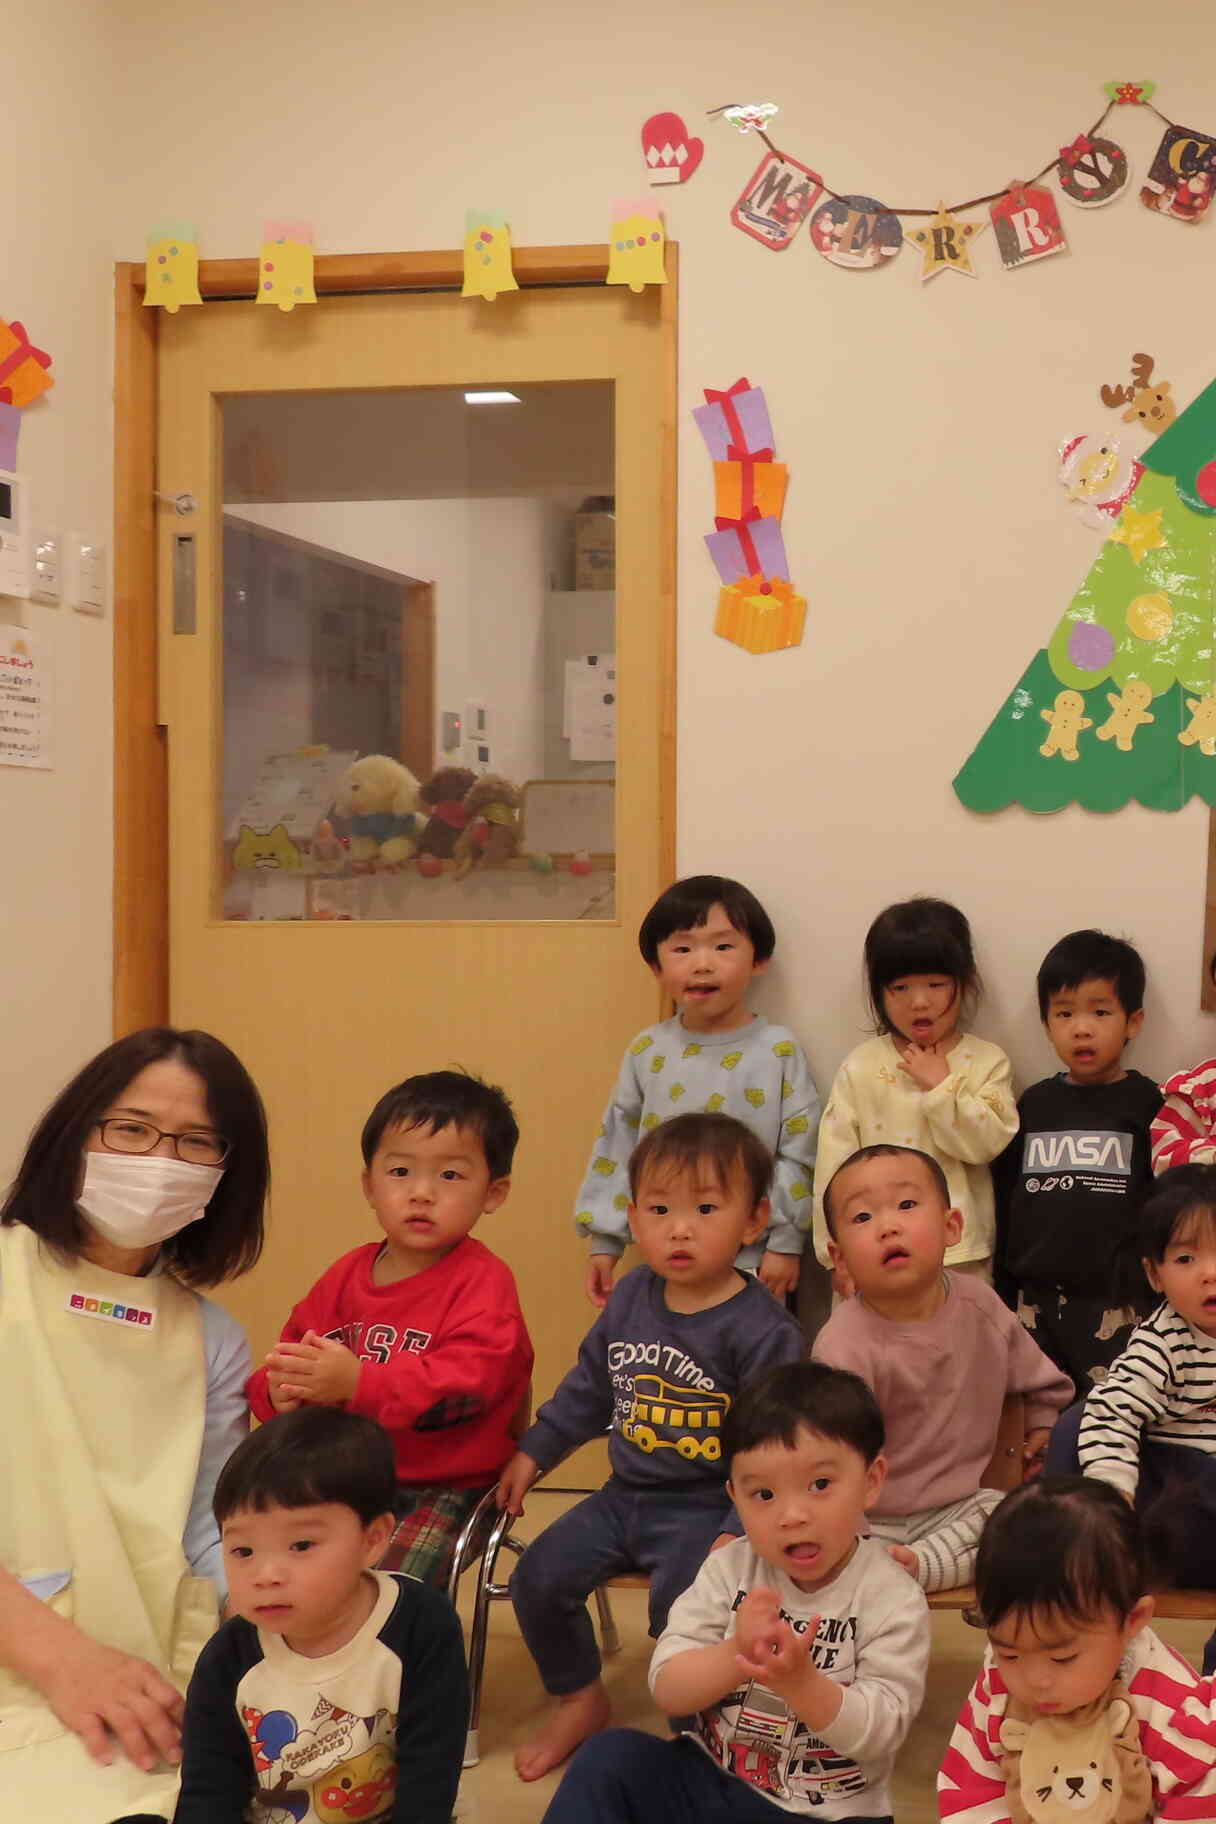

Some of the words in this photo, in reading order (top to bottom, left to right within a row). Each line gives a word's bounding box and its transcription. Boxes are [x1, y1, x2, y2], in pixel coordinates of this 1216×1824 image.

[1027, 1135, 1125, 1169] NASA
[607, 1340, 662, 1371] Good
[662, 1345, 715, 1392] Time
